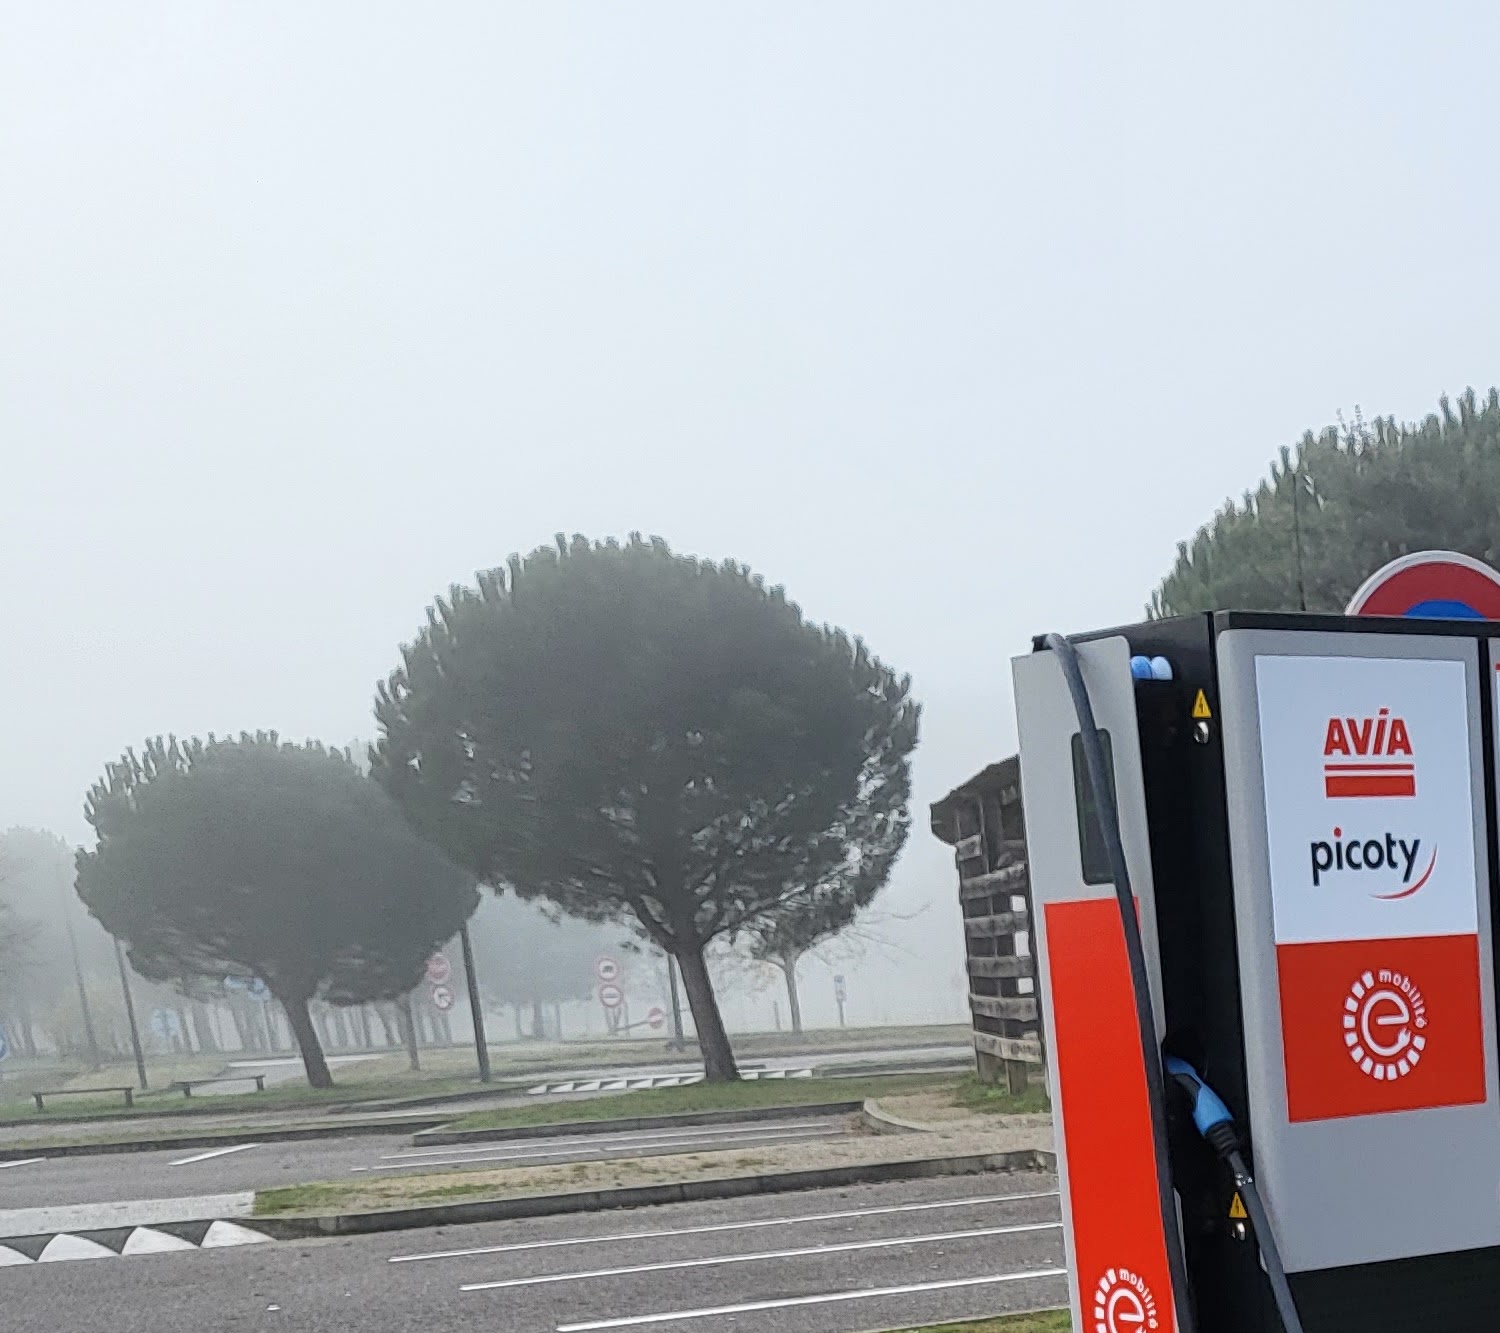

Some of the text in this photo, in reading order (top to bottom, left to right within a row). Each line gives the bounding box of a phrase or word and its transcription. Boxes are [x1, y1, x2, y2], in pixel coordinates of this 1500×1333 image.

[1310, 826, 1421, 887] picoty
[1361, 989, 1410, 1057] e
[1379, 969, 1428, 1029] mobilité
[1119, 1268, 1159, 1329] mobilité
